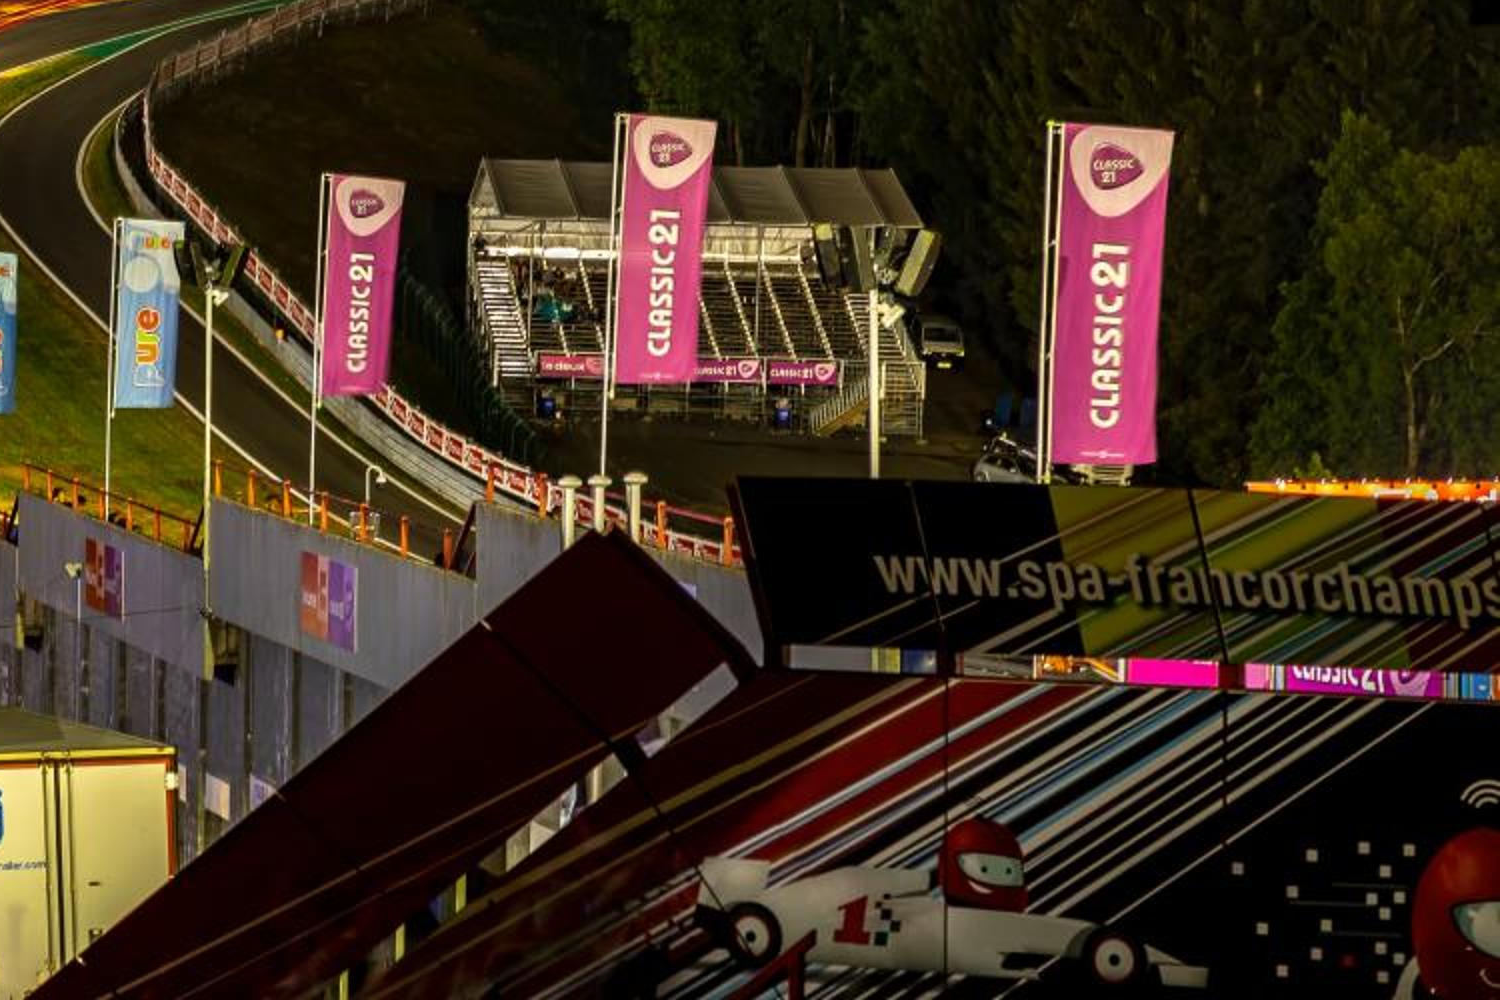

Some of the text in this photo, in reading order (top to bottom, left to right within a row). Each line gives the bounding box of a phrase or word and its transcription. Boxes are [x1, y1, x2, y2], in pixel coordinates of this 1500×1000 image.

[1093, 158, 1134, 184] CLASSIC 21
[347, 252, 375, 373] CLASSIC 21
[648, 210, 680, 357] CLASSIC 21
[1090, 243, 1131, 429] CLASSIC 21
[832, 894, 874, 947] 1
